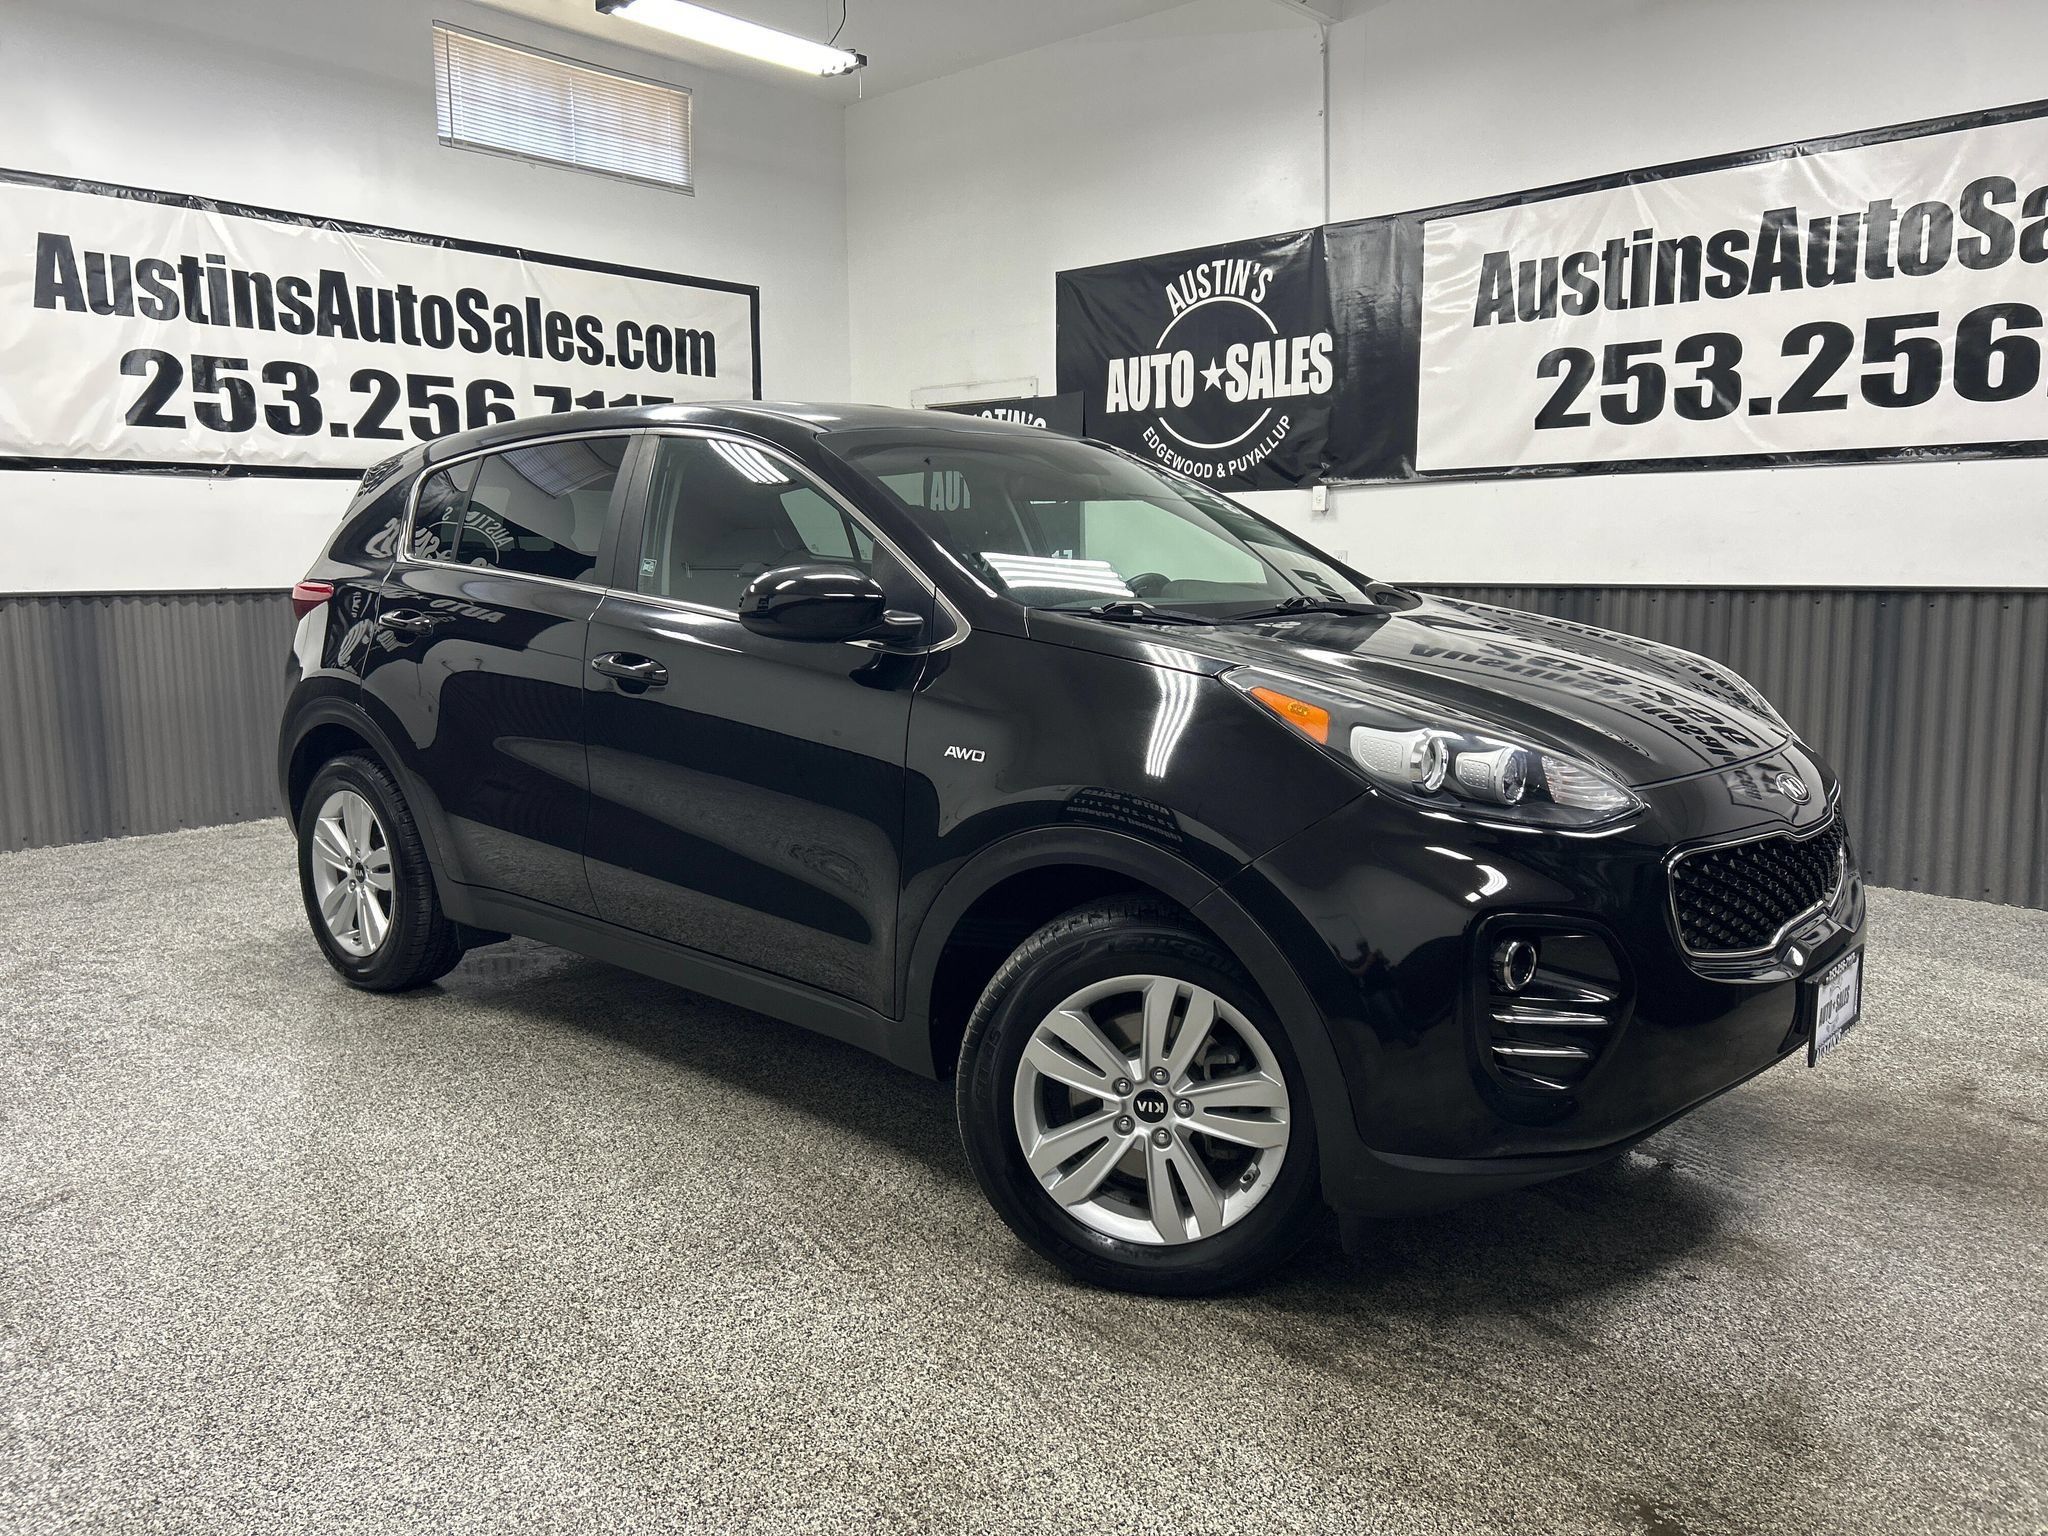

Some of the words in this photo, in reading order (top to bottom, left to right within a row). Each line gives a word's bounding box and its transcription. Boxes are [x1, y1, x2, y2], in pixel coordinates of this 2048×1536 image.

[33, 231, 717, 377] AustinsAutoSales.com
[1165, 258, 1274, 318] AUSTIN'S
[1105, 350, 1195, 413] AUTO
[1225, 332, 1334, 403] SALES
[1534, 302, 2048, 430] 253.256
[1142, 426, 1213, 478] EDGEWOOD
[1216, 462, 1226, 478] &
[1228, 415, 1291, 476] PUYALLUP
[944, 745, 986, 763] AWD
[1136, 1100, 1165, 1114] KIA
